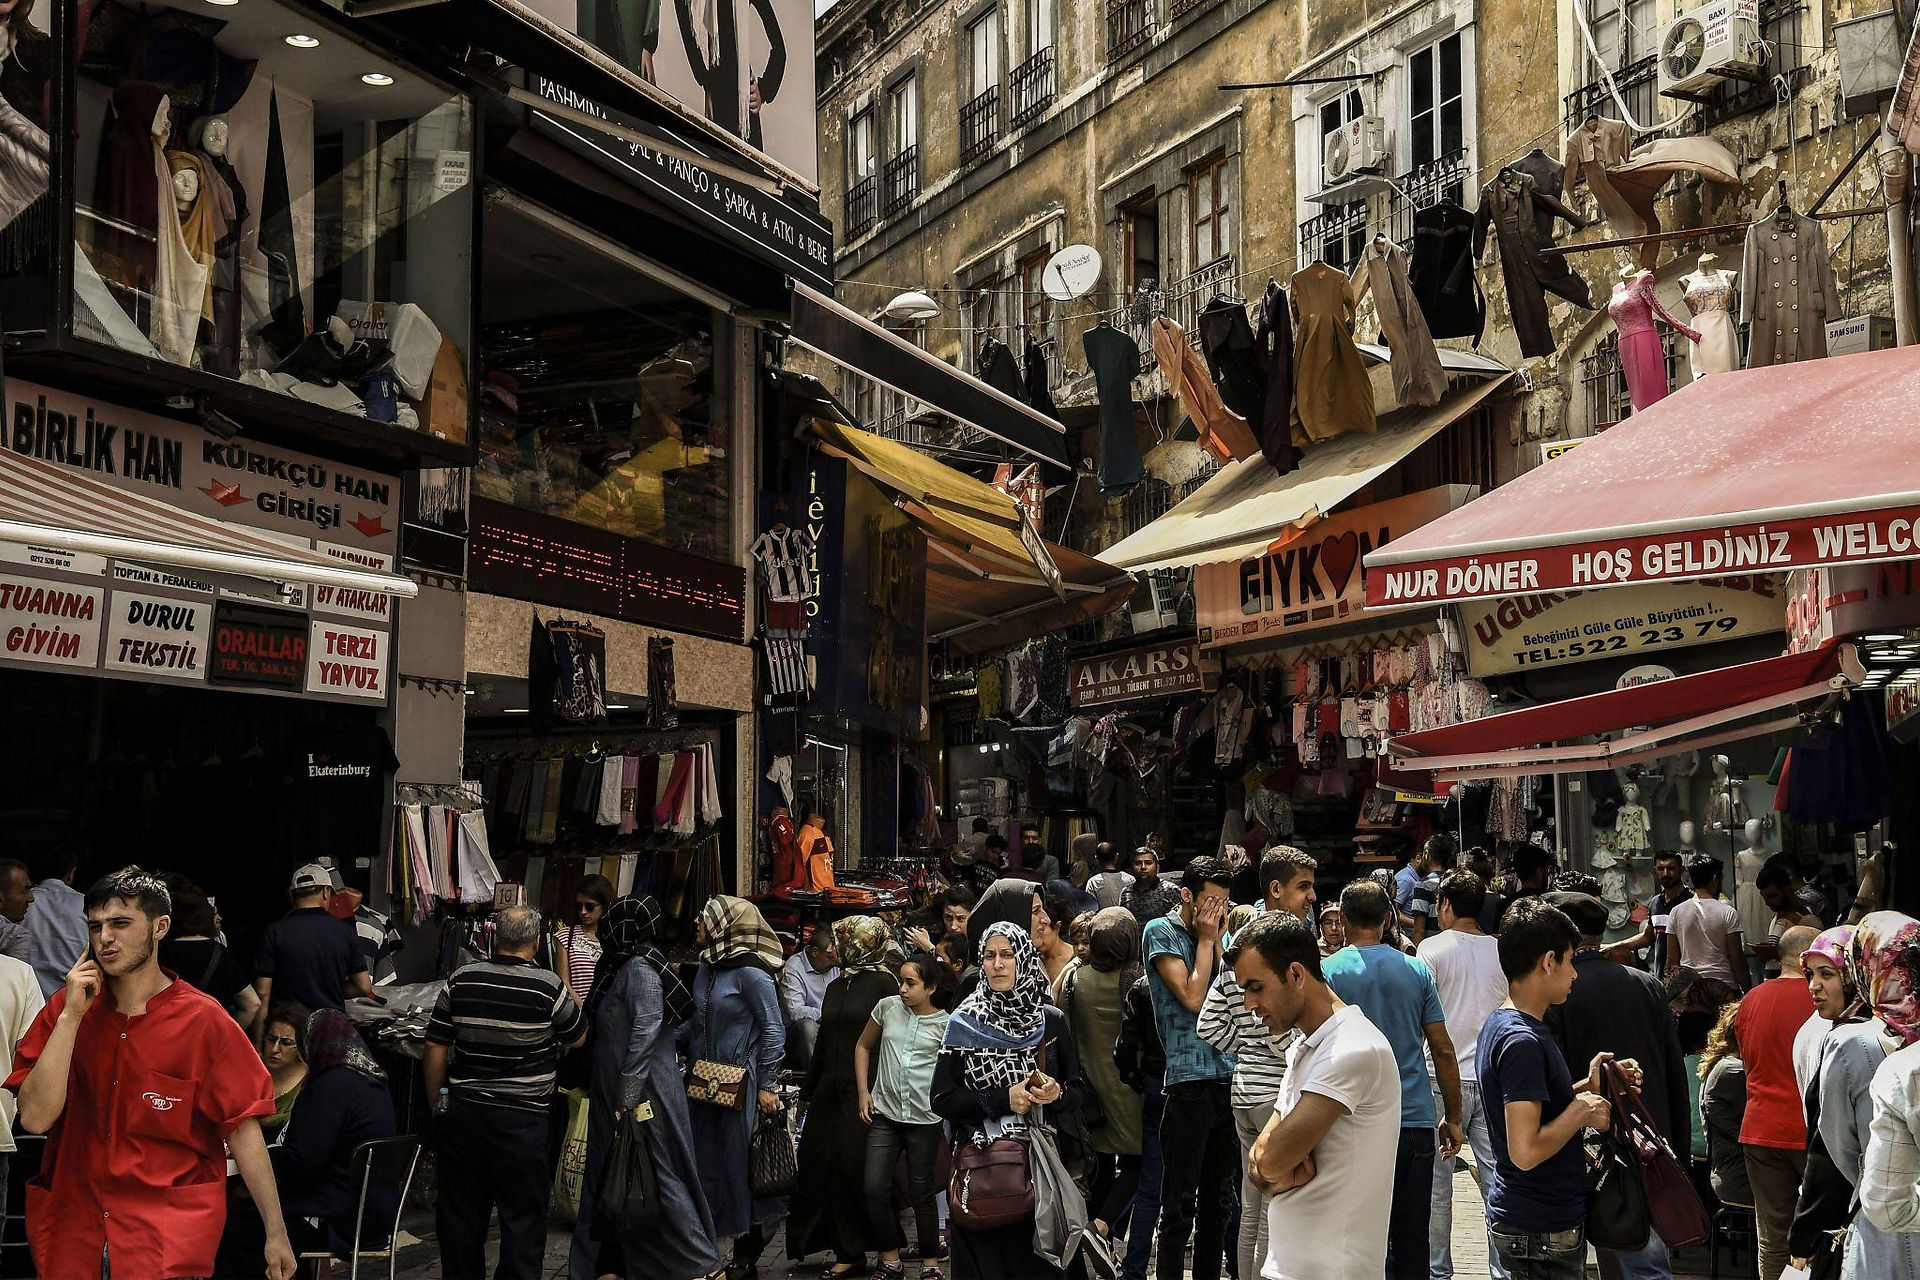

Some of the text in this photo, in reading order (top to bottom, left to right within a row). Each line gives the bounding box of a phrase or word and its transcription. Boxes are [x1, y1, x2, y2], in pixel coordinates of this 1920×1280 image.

[1708, 7, 1726, 21] BAXI
[1353, 136, 1359, 146] LG
[669, 155, 709, 194] PANÇO
[713, 182, 721, 201] &
[724, 187, 757, 224] ŞAPKA
[761, 212, 769, 230] &
[772, 218, 794, 246] ATKI
[798, 233, 805, 250] &
[807, 236, 828, 266] BERE
[1829, 323, 1865, 339] SAMSUNG
[13, 394, 183, 491] BİRLİK HAN
[202, 439, 390, 506] KÜRKÇÜ HAN
[256, 490, 342, 530] GİRİŞİ
[29, 554, 44, 564] 0212
[1384, 569, 1439, 600] NUR
[1446, 558, 1539, 596] DÖNER
[1572, 547, 1633, 583] HOŞ
[1642, 525, 1792, 576] GELDİNİZ
[114, 566, 151, 582] TOPTAN
[152, 573, 160, 584] &
[161, 574, 213, 593] PERAKENDE
[0, 583, 95, 621] TUANNA
[128, 600, 195, 632] DURUL
[335, 586, 388, 616] ATAKLAR
[6, 622, 81, 659] GİYİM
[1523, 626, 1580, 647] Bebeğinizi
[1583, 621, 1611, 637] Güle
[1614, 615, 1644, 631] Güle
[1647, 605, 1705, 627] Büyütün
[1639, 626, 1685, 647] 23
[1695, 616, 1739, 637] 79
[118, 639, 197, 670] TEKSTİL
[216, 627, 305, 662] ORALLAR
[325, 631, 377, 661] TERZİ
[318, 660, 380, 691] YAVUZ
[1127, 679, 1150, 694] TÜLBENT
[1186, 672, 1196, 684] 02
[307, 752, 314, 764] I
[308, 763, 371, 778] Ekaterinburg
[499, 889, 512, 905] 10
